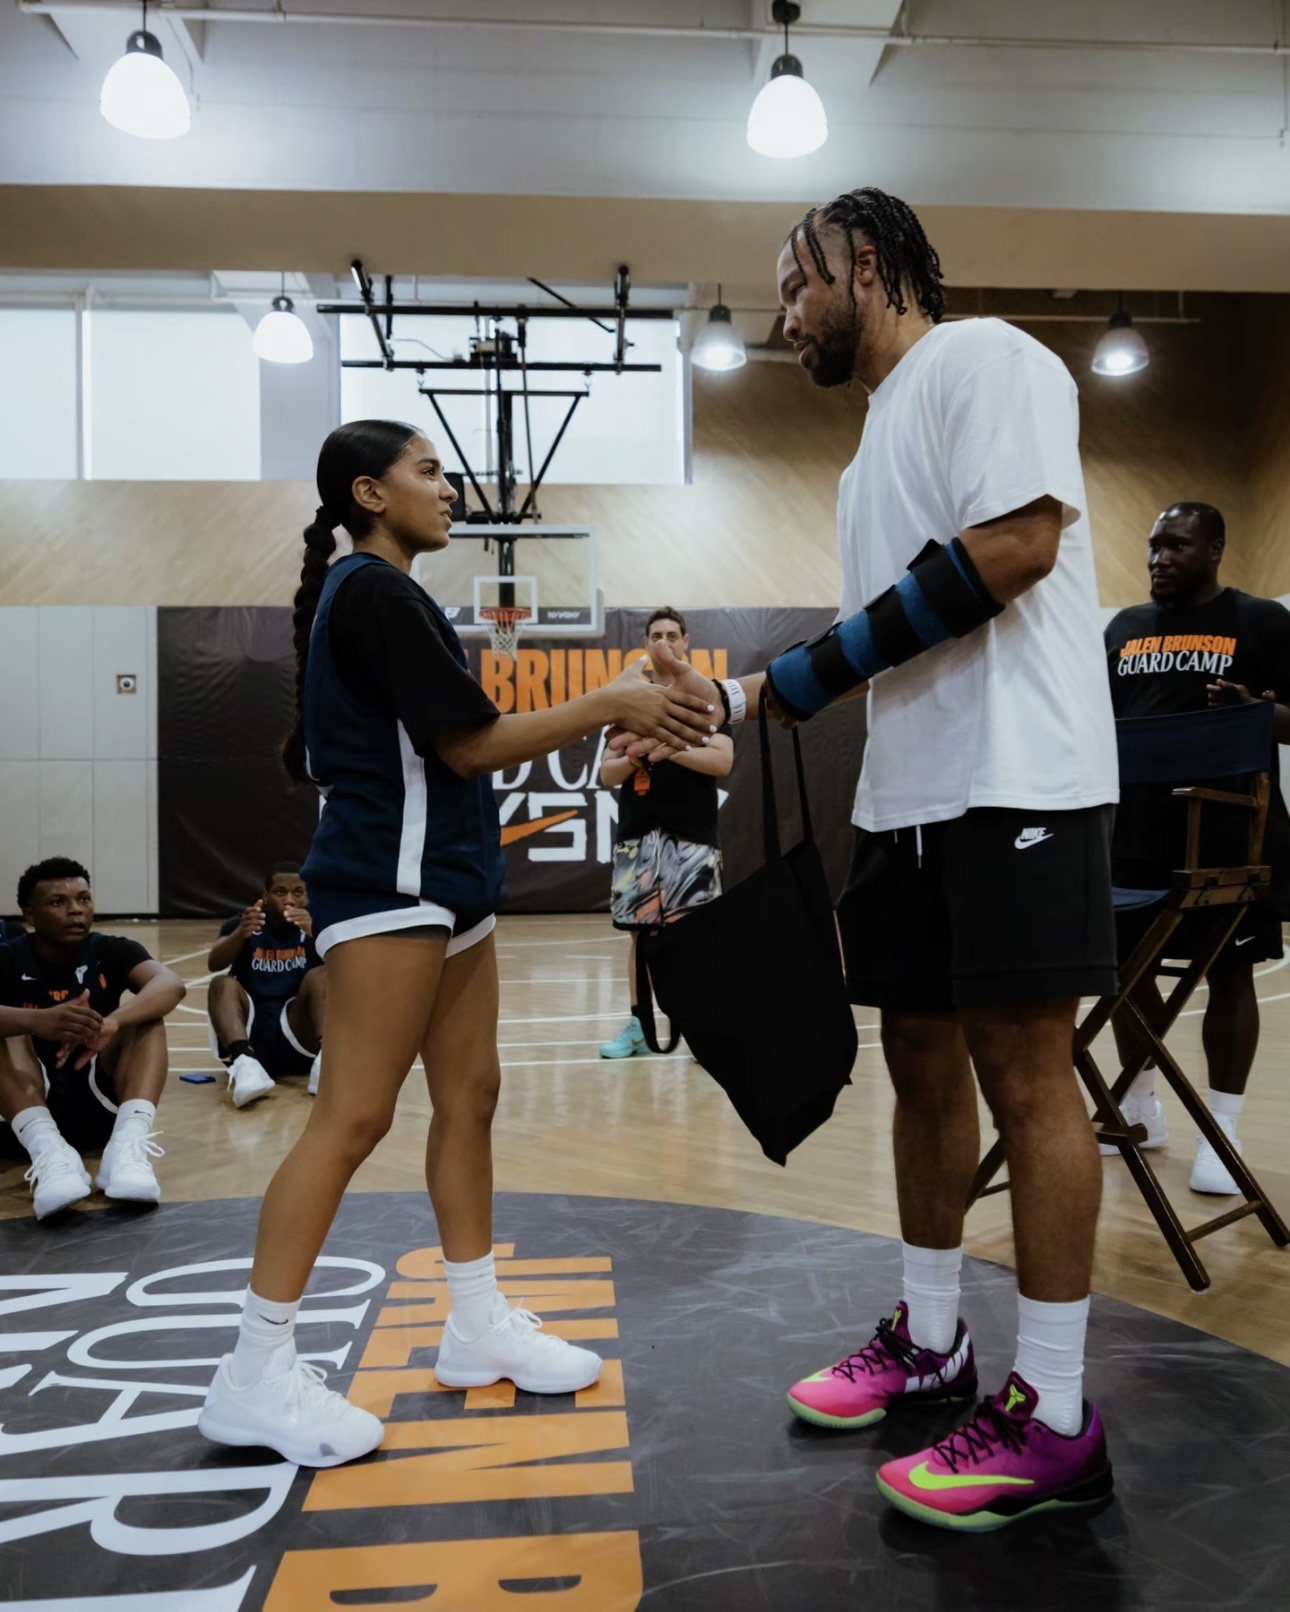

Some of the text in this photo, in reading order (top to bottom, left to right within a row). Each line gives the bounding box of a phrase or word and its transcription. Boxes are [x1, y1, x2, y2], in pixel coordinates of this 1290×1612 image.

[1119, 634, 1237, 658] JALEN BRUNSON
[1117, 650, 1233, 676] GUARD CAMP
[1020, 827, 1047, 840] NIKE
[251, 957, 284, 973] GUARD
